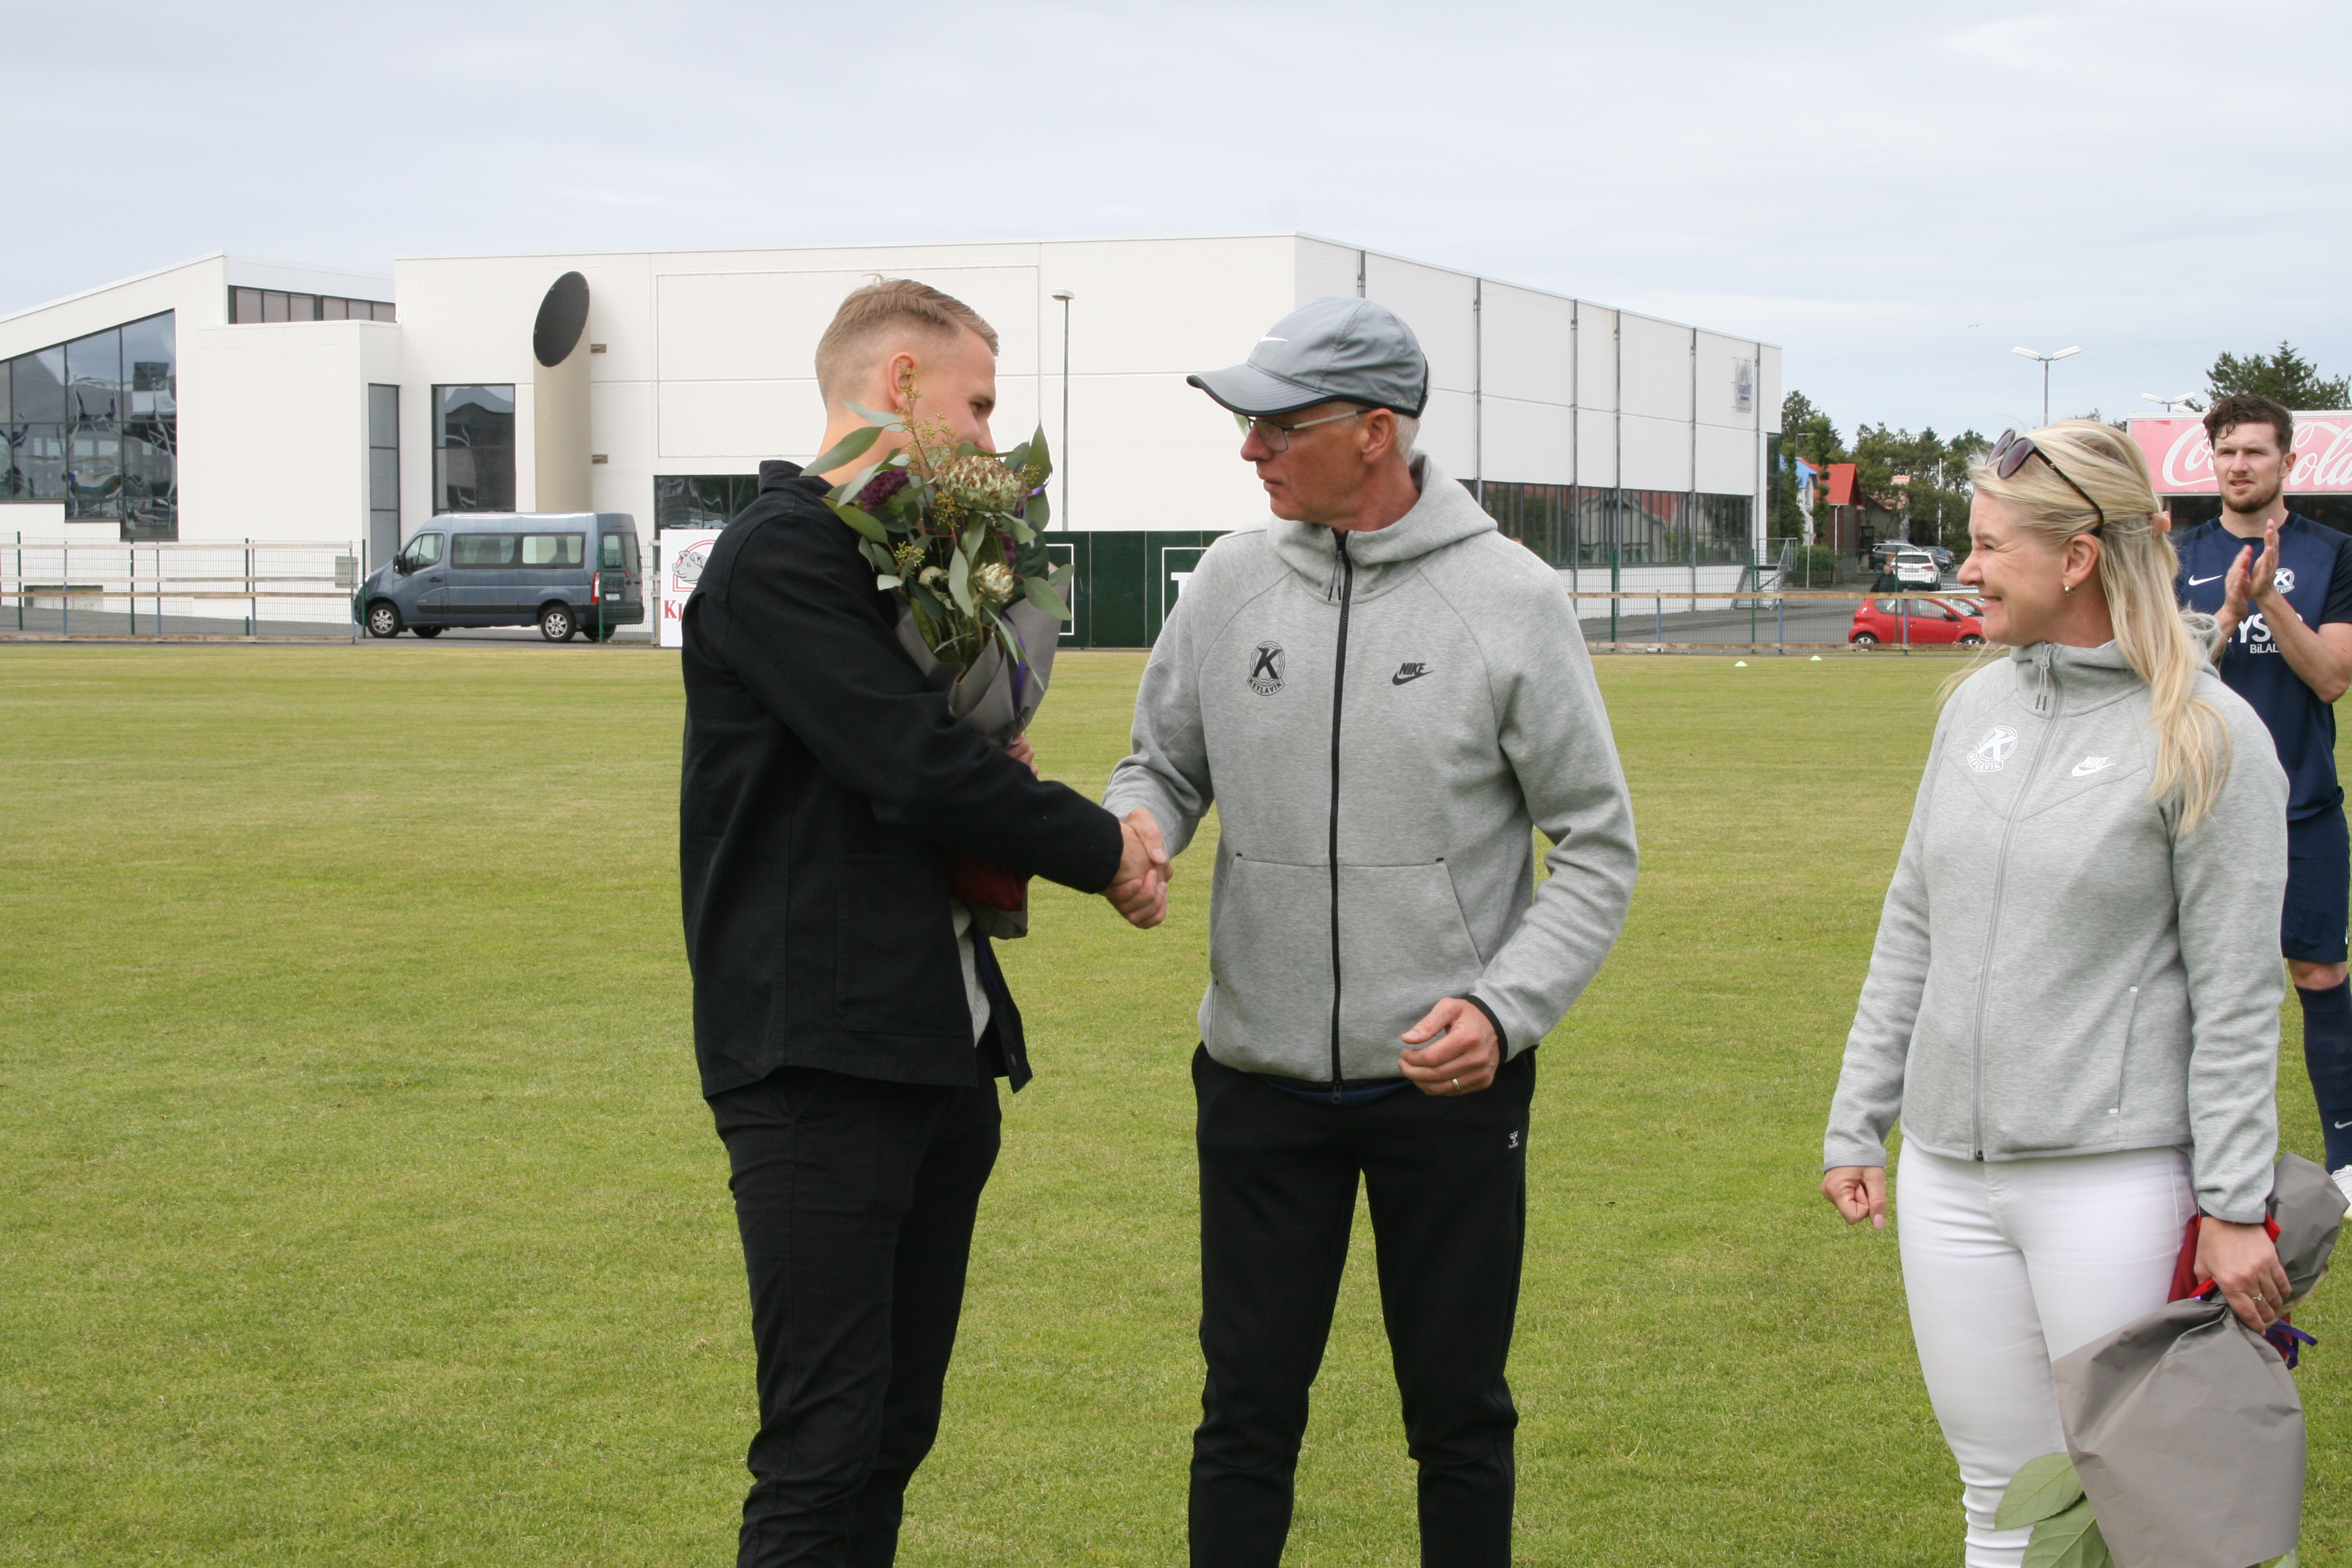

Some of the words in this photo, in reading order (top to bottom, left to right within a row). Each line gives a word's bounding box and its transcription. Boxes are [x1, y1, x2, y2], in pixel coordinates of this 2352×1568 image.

[664, 599, 682, 622] KJ
[2250, 643, 2280, 654] BiLAL
[1252, 647, 1282, 679] K
[1398, 662, 1426, 675] NIKE
[1249, 678, 1282, 694] KEFLAVIK
[1968, 753, 2001, 770] KEFLAVIK
[2080, 756, 2109, 768] NIKE
